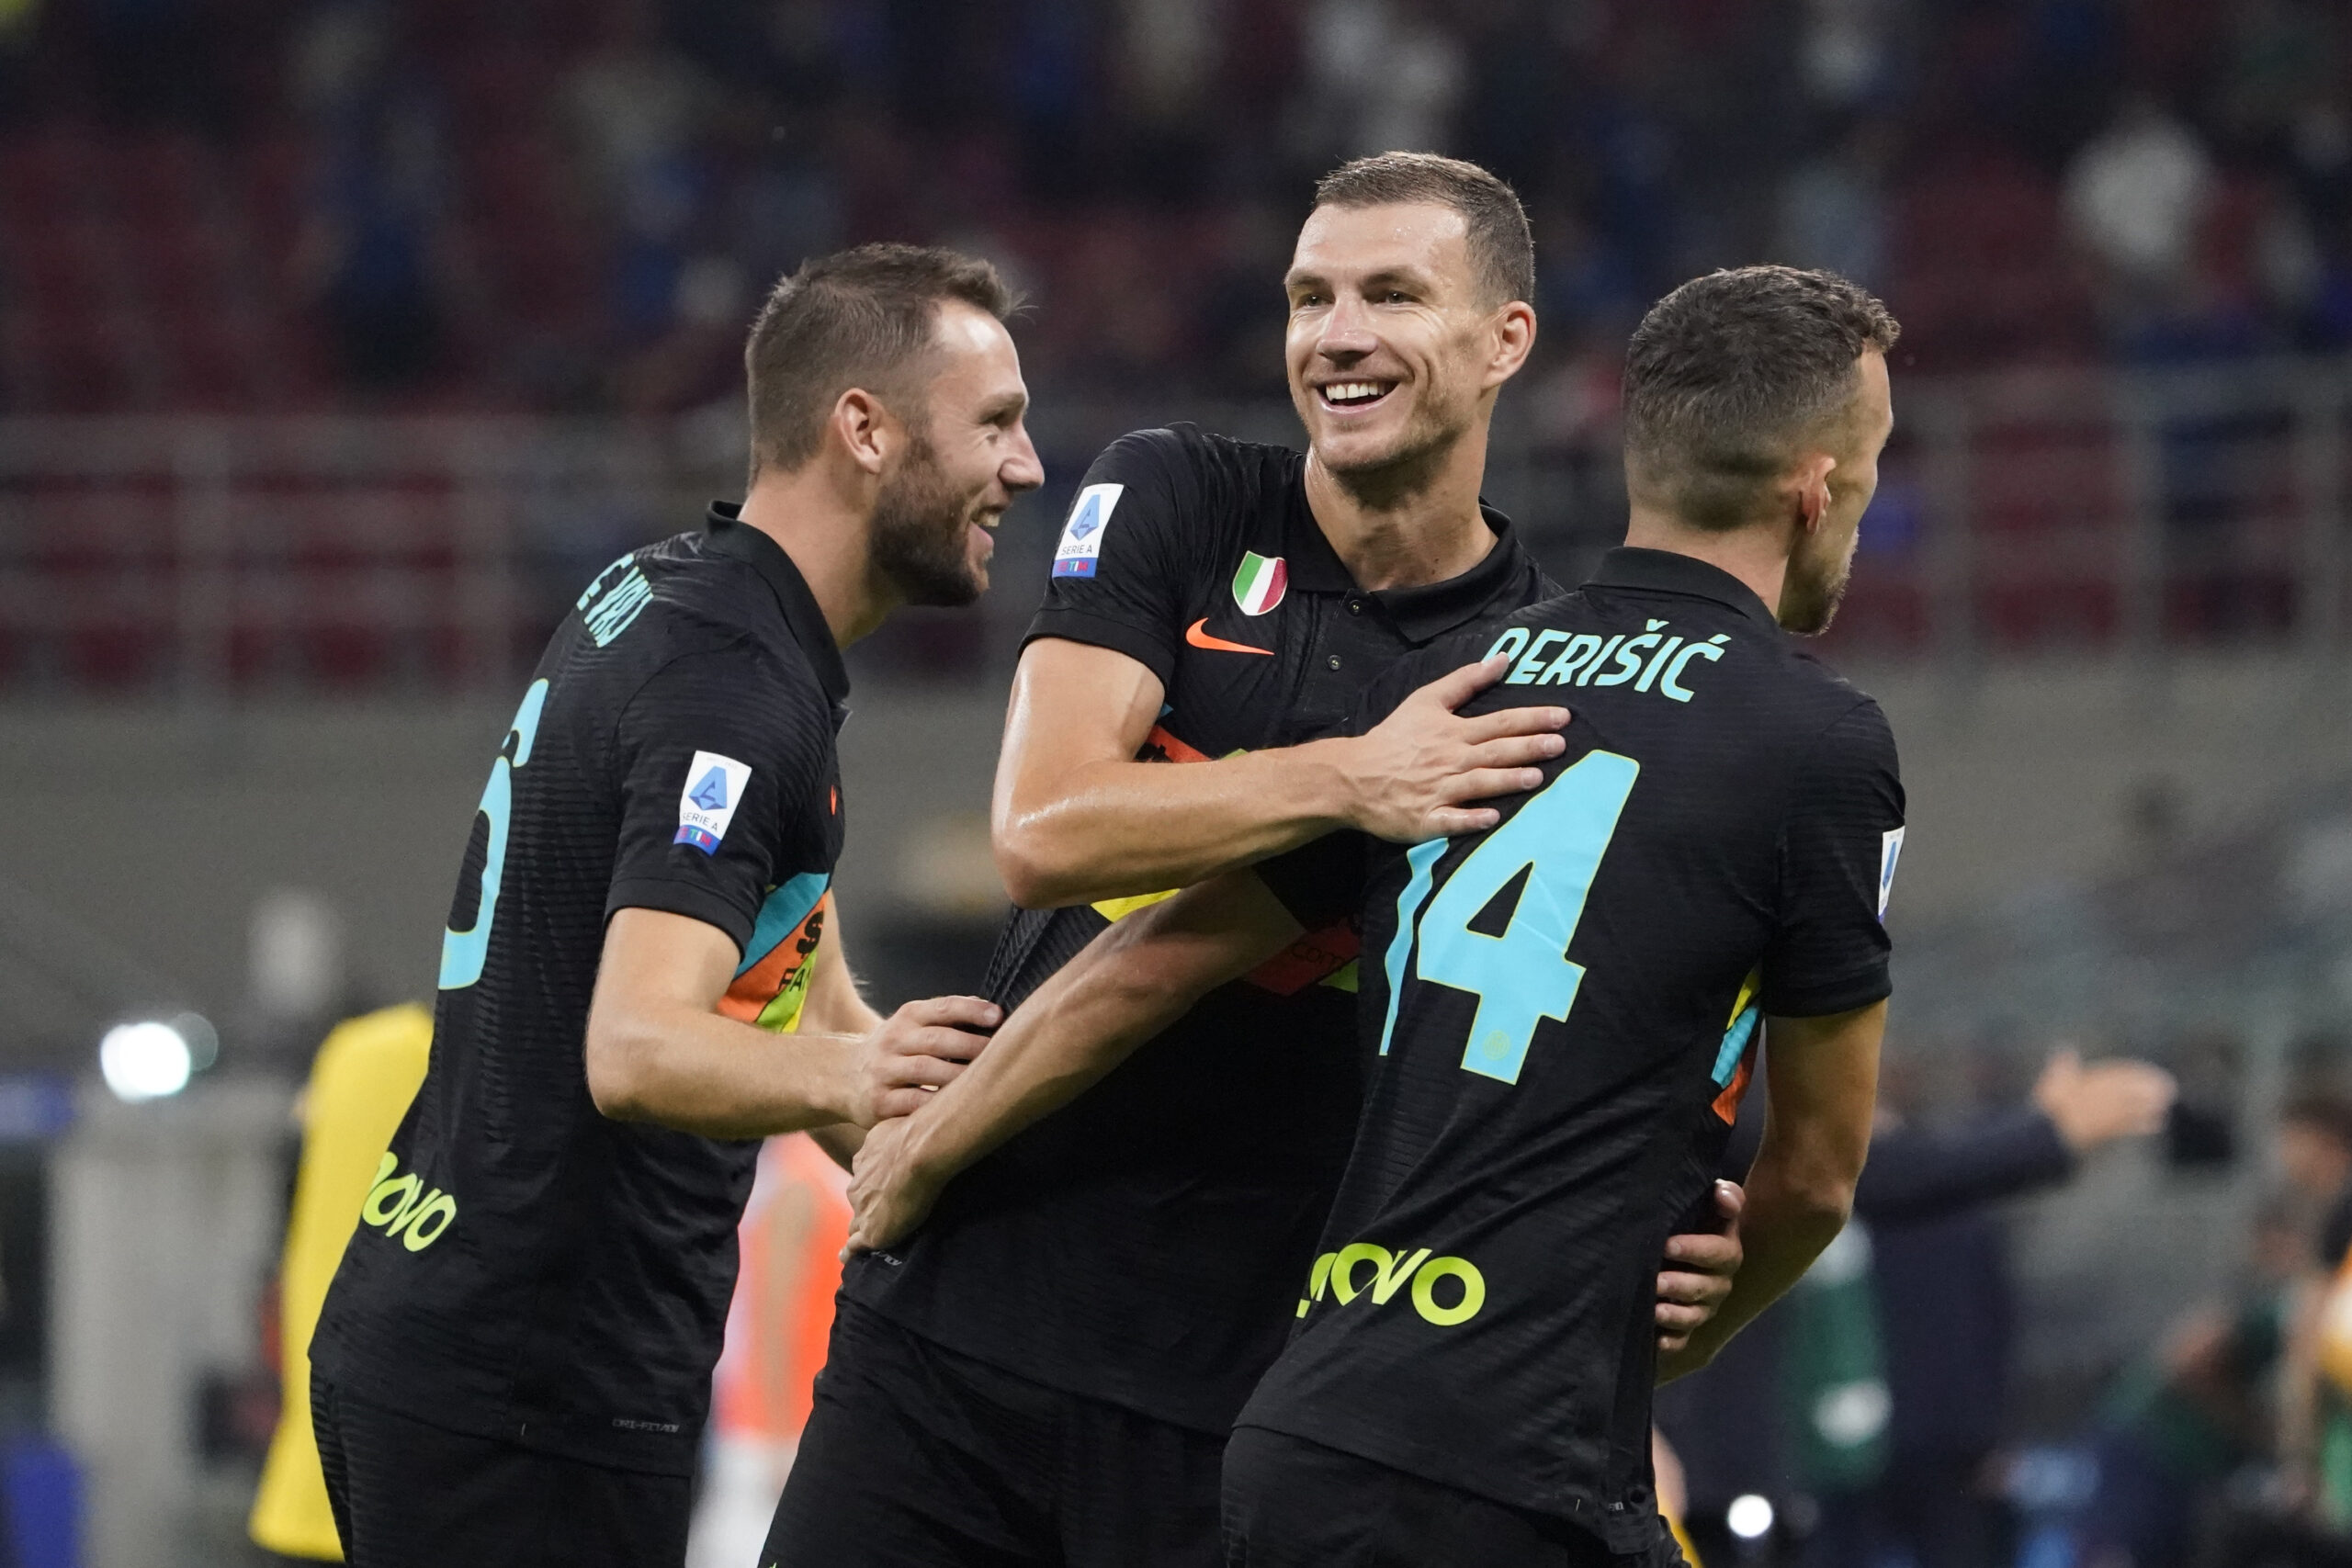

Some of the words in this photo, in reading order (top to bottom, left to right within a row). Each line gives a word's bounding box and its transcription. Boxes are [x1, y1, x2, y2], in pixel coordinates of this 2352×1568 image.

[1061, 545, 1084, 555] SERIE
[1086, 545, 1092, 554] A
[1069, 560, 1089, 572] TIM
[583, 565, 654, 649] VRIJ
[1481, 618, 1732, 703] PERIŠIĆ
[711, 822, 718, 831] A
[690, 829, 713, 847] TIM
[1378, 749, 1641, 1086] 14
